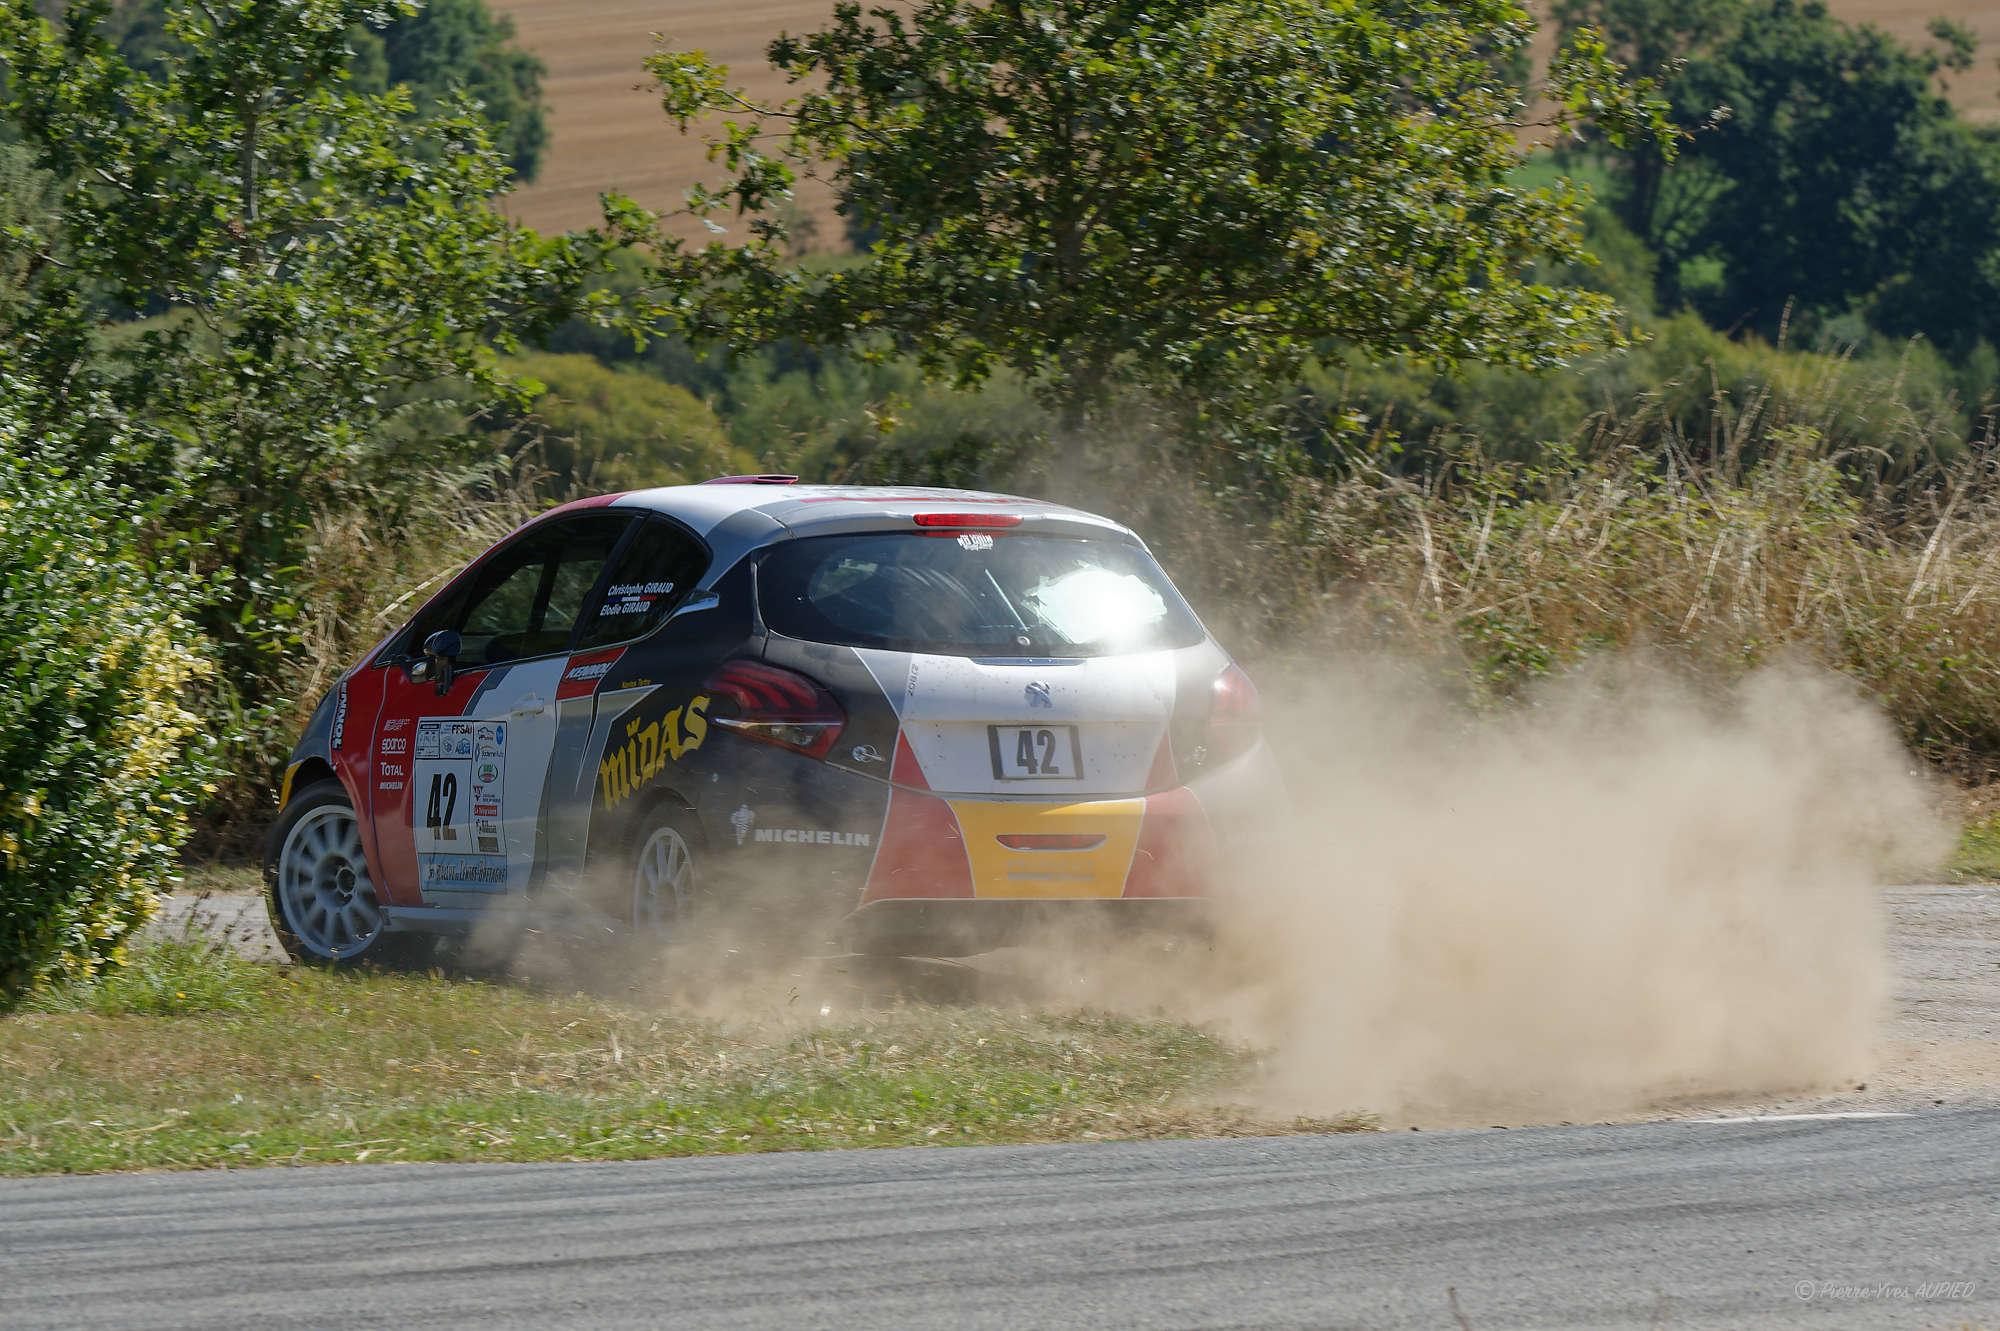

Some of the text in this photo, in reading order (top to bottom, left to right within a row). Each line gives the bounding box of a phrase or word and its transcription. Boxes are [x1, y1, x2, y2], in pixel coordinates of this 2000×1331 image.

[608, 582, 674, 597] Christophe GIRAUD
[600, 601, 651, 616] Elodie GIRAUD
[451, 724, 470, 735] FFSA
[381, 738, 407, 751] sparco
[1016, 730, 1060, 775] 42
[426, 773, 457, 841] 42
[755, 829, 870, 847] MICHELIN
